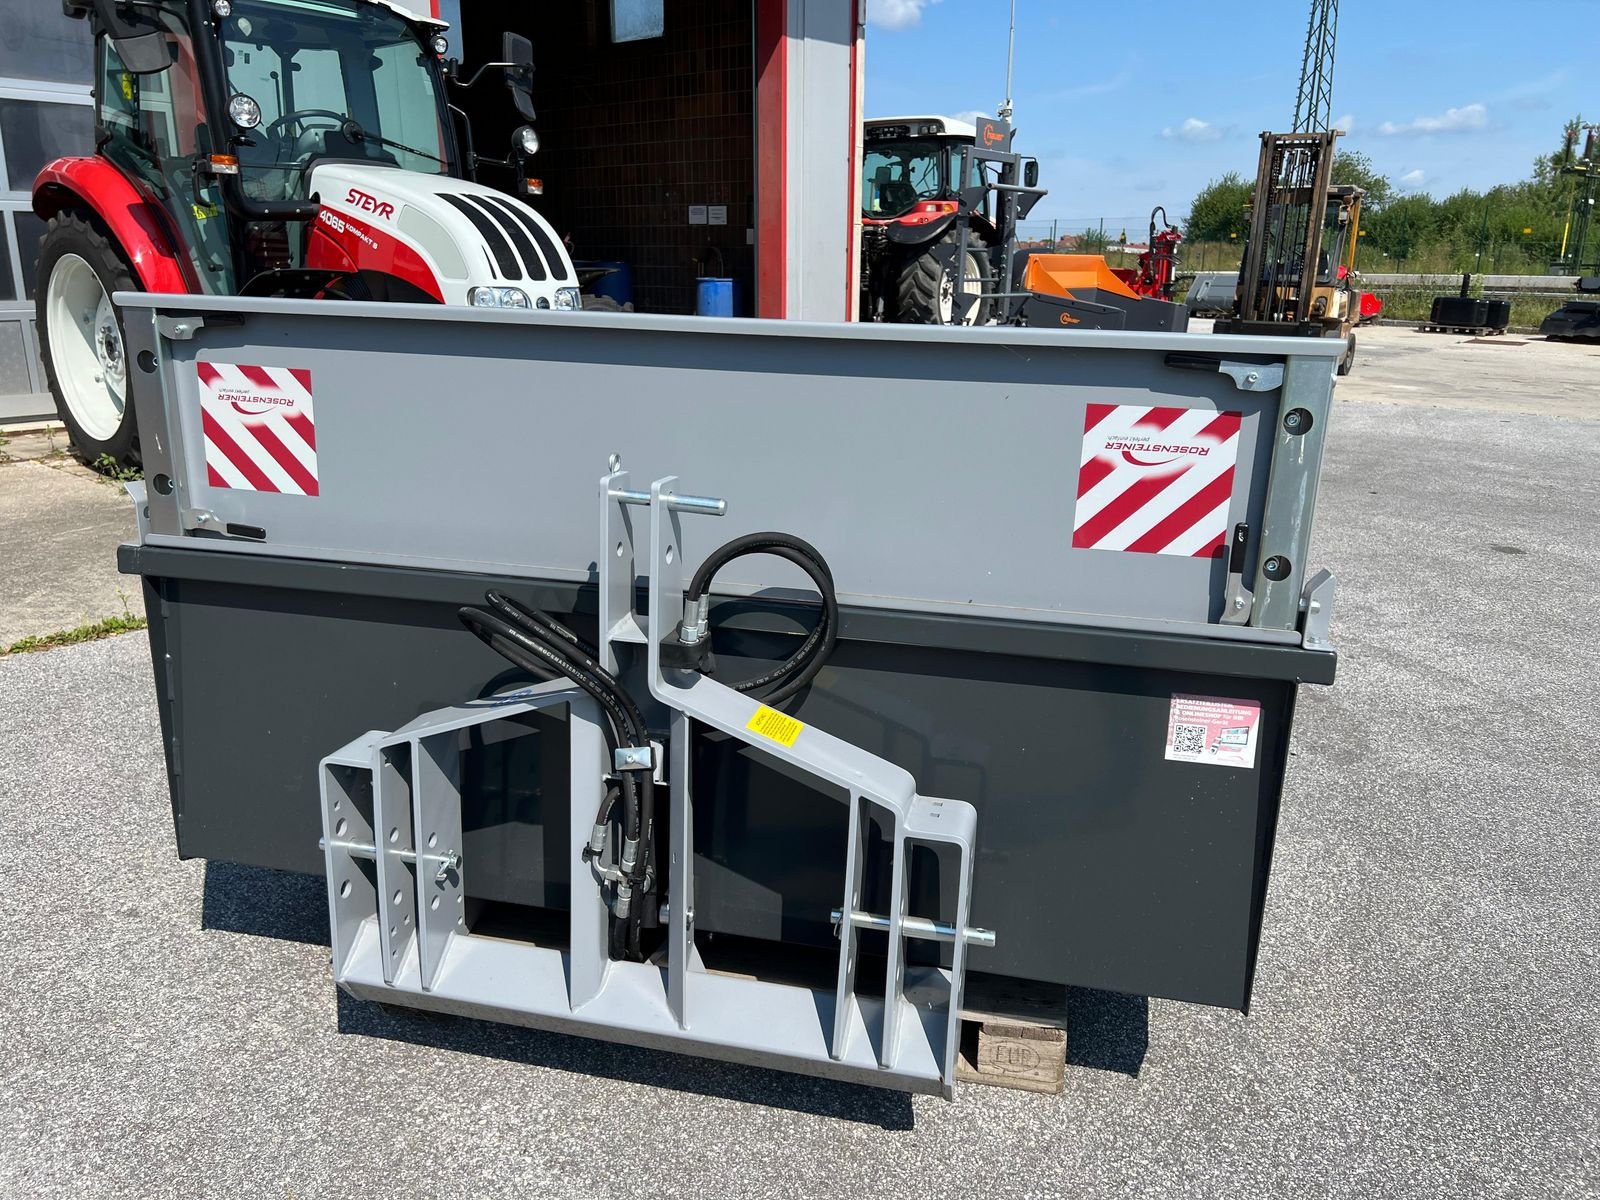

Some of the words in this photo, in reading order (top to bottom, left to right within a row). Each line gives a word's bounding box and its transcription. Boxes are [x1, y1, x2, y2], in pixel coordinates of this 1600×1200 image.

[345, 188, 395, 220] STEYR
[319, 210, 346, 234] 4065
[345, 223, 374, 246] KOMPAKT
[217, 393, 295, 407] ROSENSTEINER
[1104, 441, 1211, 456] ROSENSTEINER
